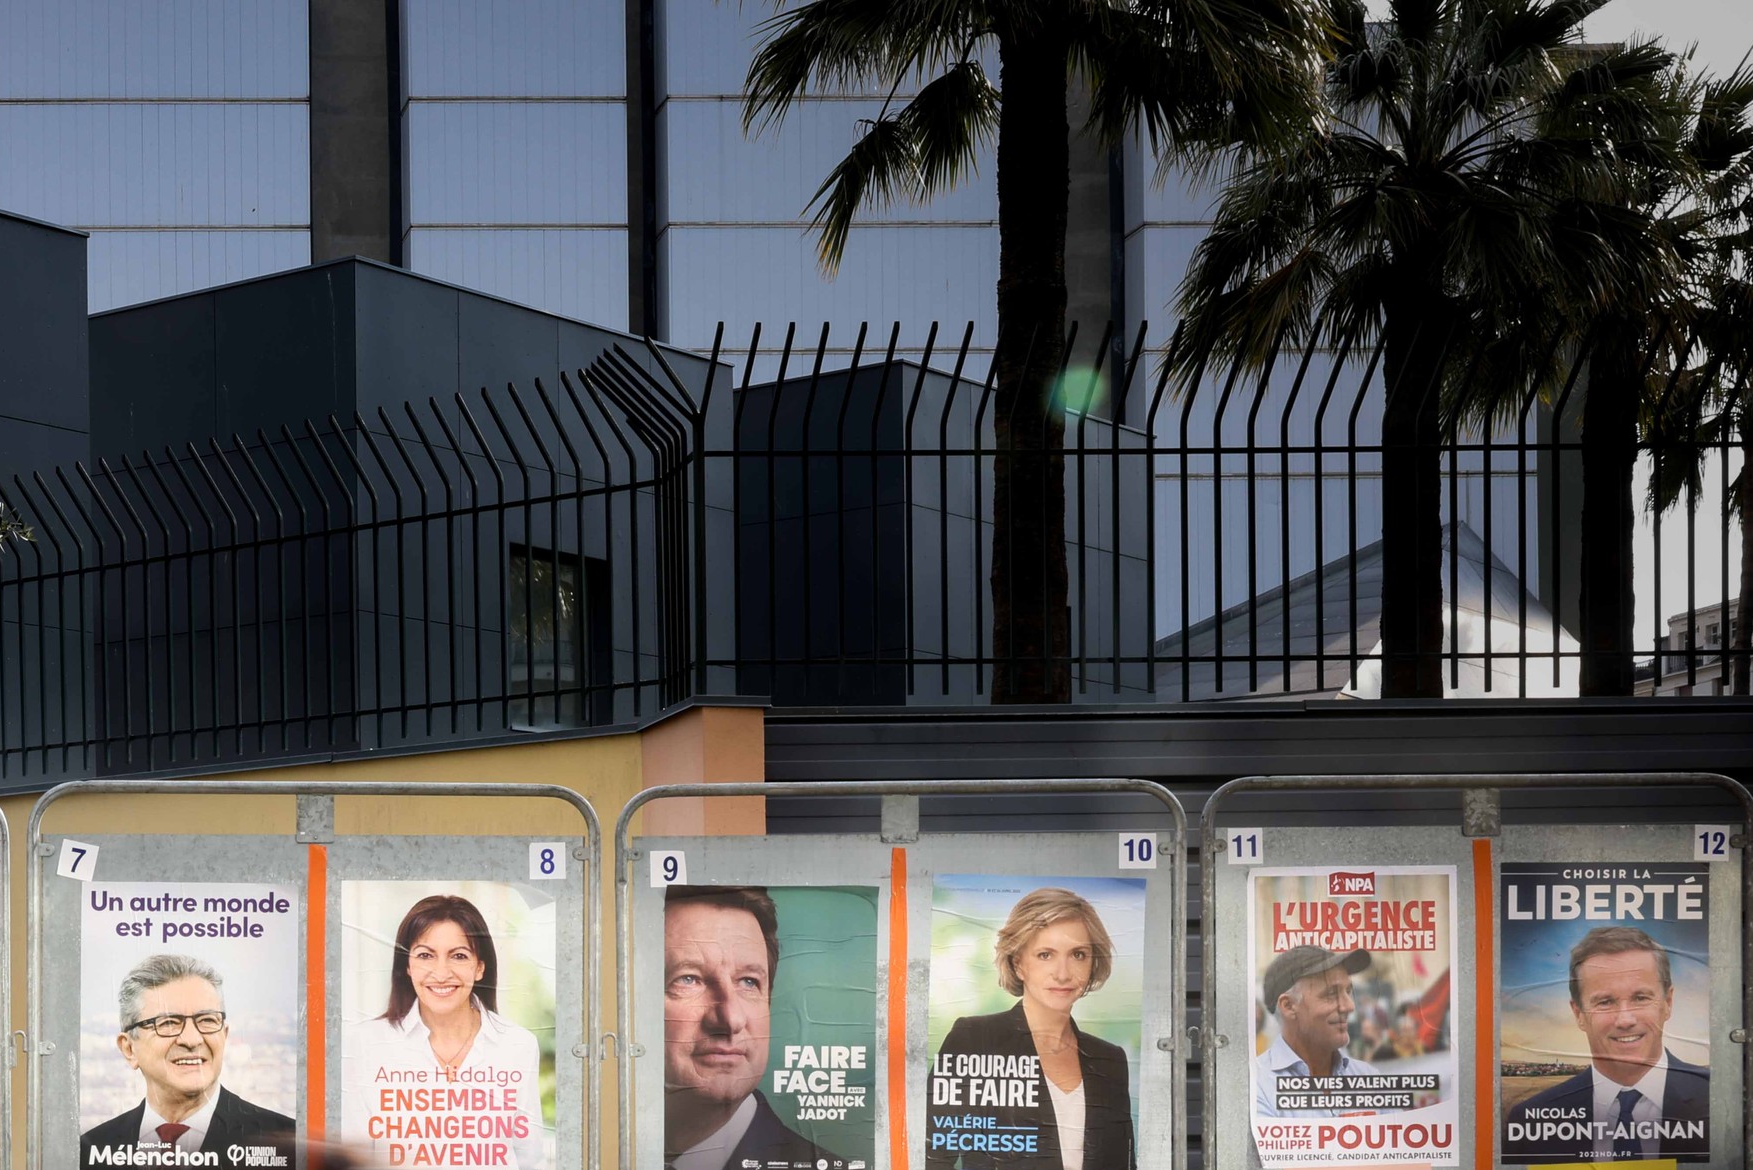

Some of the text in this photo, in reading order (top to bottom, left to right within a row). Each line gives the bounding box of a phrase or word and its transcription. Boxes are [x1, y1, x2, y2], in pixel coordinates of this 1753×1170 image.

[1123, 838, 1153, 862] 10
[1232, 834, 1257, 857] 11
[1699, 832, 1726, 855] 12
[71, 847, 86, 872] 7
[540, 848, 556, 875] 8
[662, 856, 678, 882] 9
[1345, 878, 1374, 892] NPA
[1563, 869, 1651, 879] CHOISIR LA
[90, 891, 290, 913] Un autre monde
[1507, 876, 1703, 920] LIBERTÉ
[115, 916, 264, 943] est possible
[1275, 931, 1435, 951] ANTICAPITALISTE
[784, 1045, 867, 1070] FAIRE
[933, 1054, 1040, 1078] LE COURAGE
[375, 1066, 522, 1087] Anne Hidalgo
[773, 1070, 846, 1094] FACE
[1278, 1077, 1435, 1090] NOS VIES VALENT PLUS
[380, 1089, 518, 1112] ENSEMBLE
[797, 1095, 865, 1107] YANNICK
[932, 1078, 1039, 1107] DE FAIRE
[1278, 1094, 1410, 1109] QUE LEURS PROFITS
[796, 1108, 847, 1120] JADOT
[933, 1113, 997, 1129] VALÉRIE
[1525, 1108, 1587, 1119] NICOLAS
[368, 1116, 529, 1139] CHANGEONS
[1258, 1125, 1311, 1138] VOTEZ
[1318, 1124, 1452, 1149] POUTOU
[1507, 1121, 1704, 1142] DUPONT-AIGNAN
[136, 1141, 171, 1150] Jean-Luc
[932, 1129, 1038, 1152] PÉCRESSE
[89, 1145, 219, 1166] Mélenchon
[246, 1156, 288, 1167] POPULAIRE
[1383, 1152, 1452, 1160] ANTICAPITALISTE
